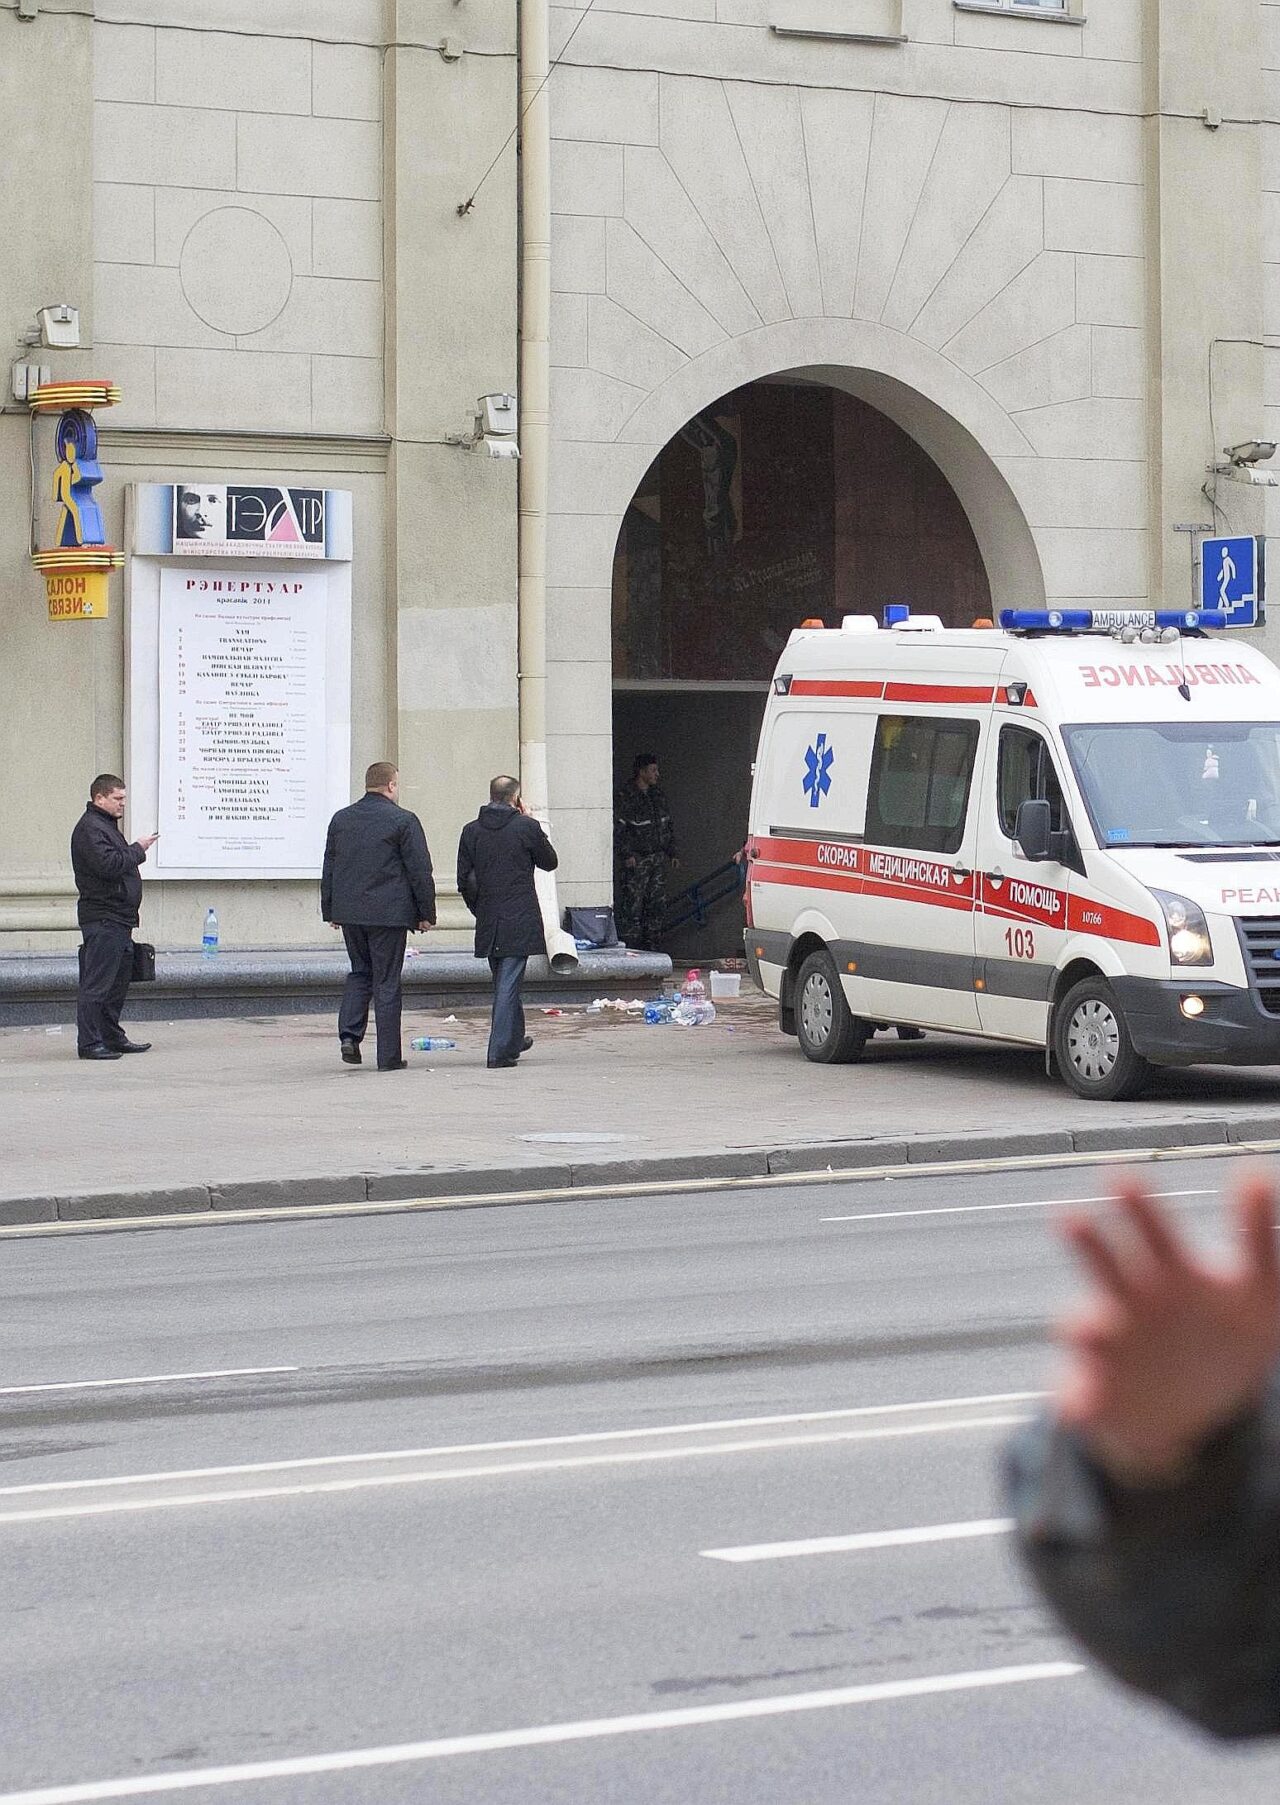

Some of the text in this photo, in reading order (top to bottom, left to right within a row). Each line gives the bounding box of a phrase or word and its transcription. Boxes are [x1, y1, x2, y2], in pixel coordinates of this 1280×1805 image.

[227, 488, 323, 542] ТЭАТР
[46, 577, 86, 596] САЛОН
[186, 579, 303, 594] РЭПЕРТУАР
[48, 597, 83, 616] СВЯЗИ
[1093, 612, 1156, 626] AMBULANCE
[817, 844, 1061, 914] СКОРАЯ МЕДИЦИНСКАЯ ПОМОЩЬ
[1081, 910, 1103, 925] 10766
[1004, 926, 1036, 960] 103
